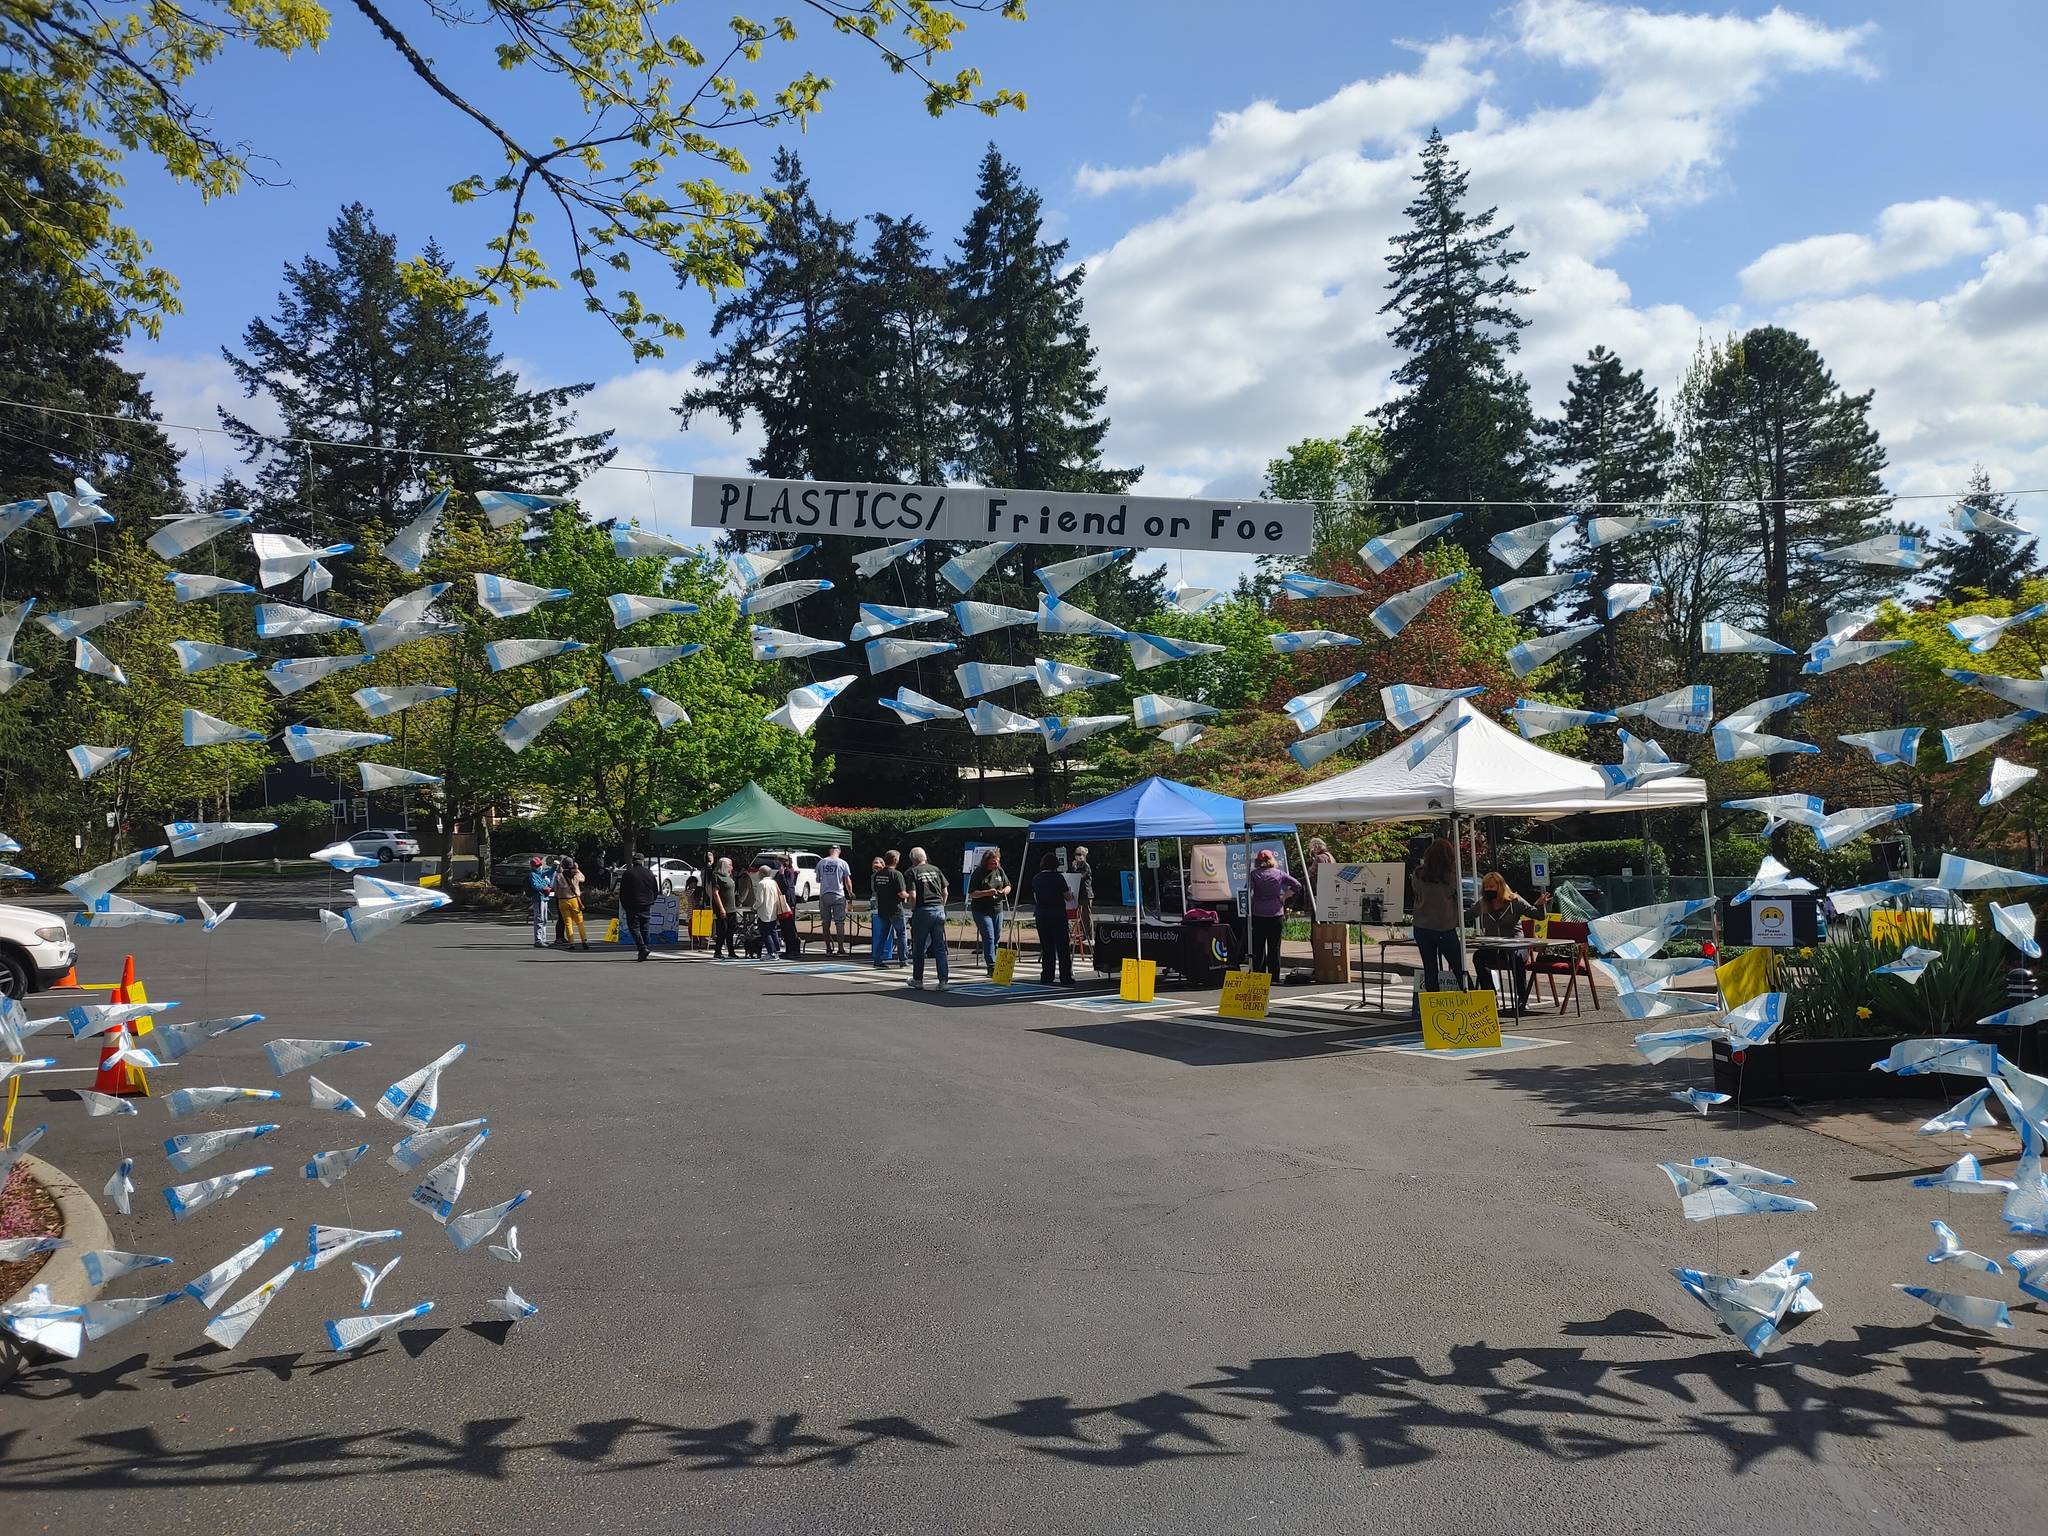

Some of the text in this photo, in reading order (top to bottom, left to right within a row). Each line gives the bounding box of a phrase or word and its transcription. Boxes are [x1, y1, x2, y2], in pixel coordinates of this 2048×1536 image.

[720, 482, 1284, 542] PLASTICS/ Friend or Foe
